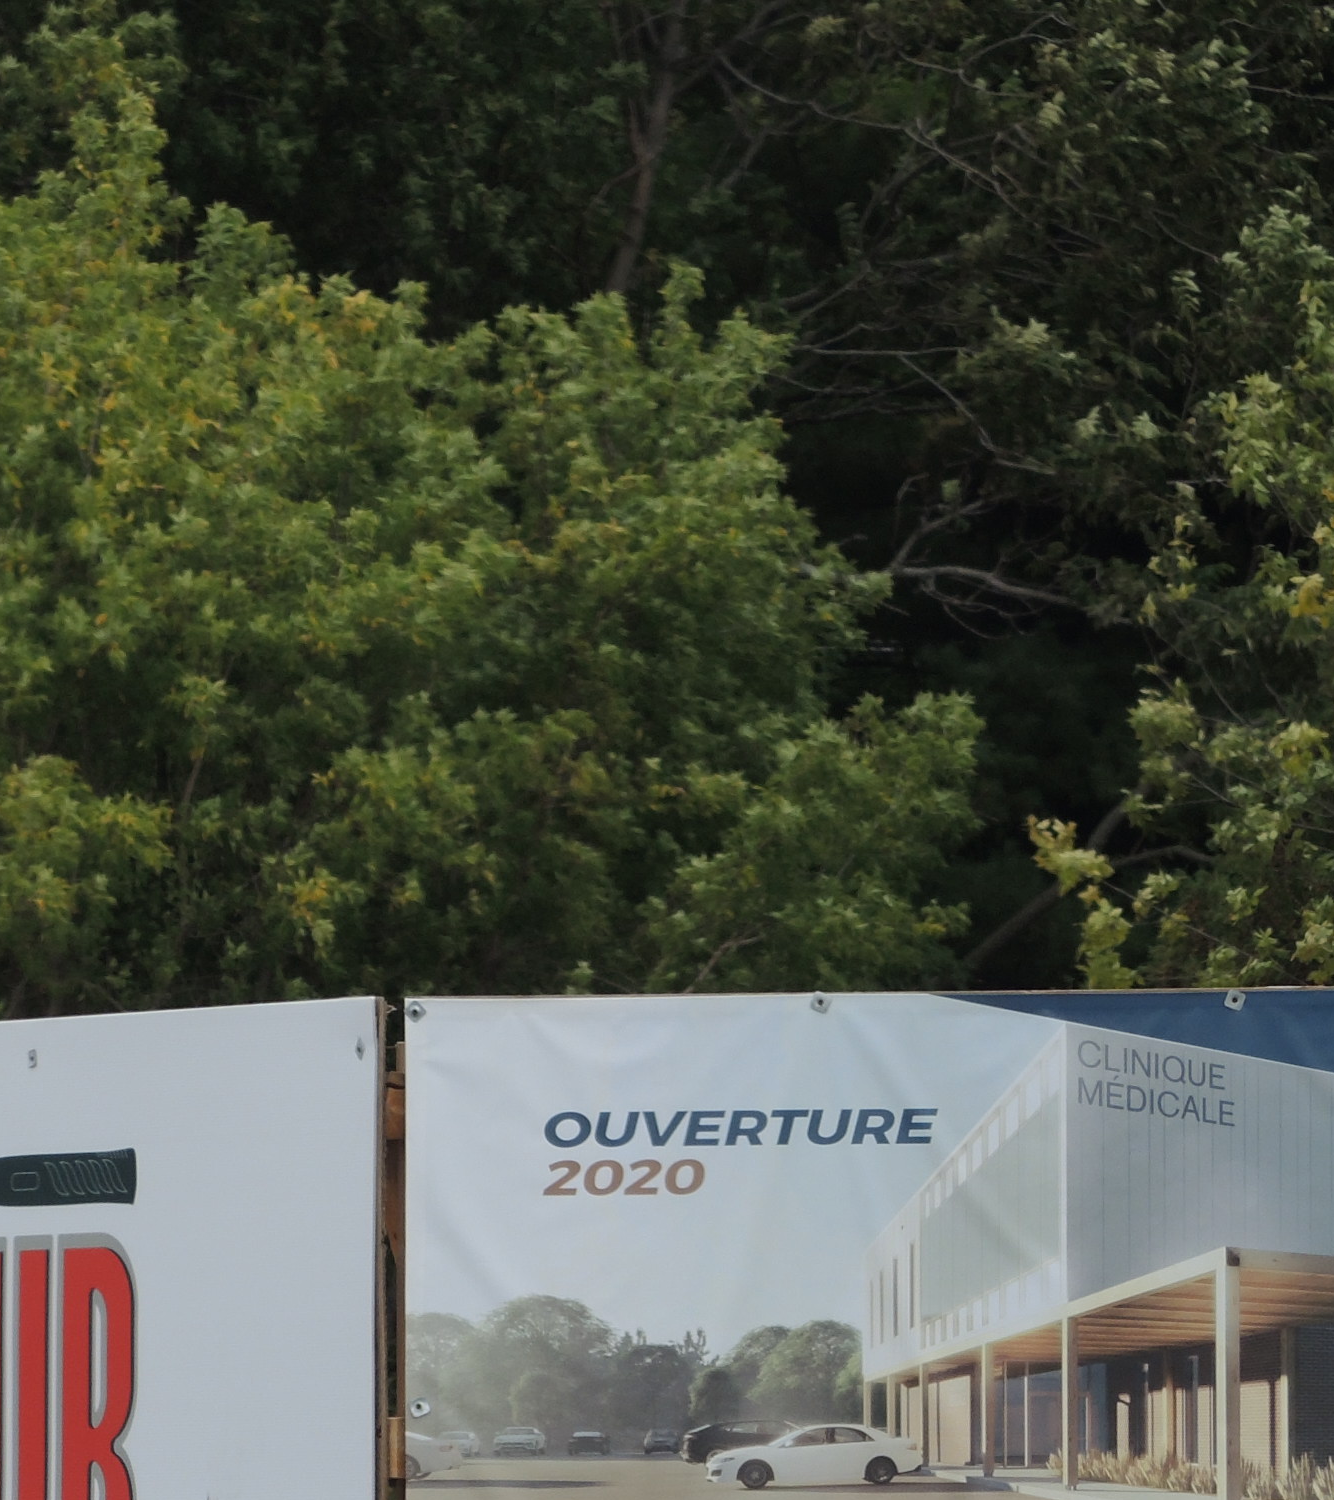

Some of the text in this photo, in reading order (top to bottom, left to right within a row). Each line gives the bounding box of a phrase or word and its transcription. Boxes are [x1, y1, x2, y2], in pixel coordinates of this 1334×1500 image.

[1077, 1040, 1226, 1090] CLINIQUE
[1077, 1075, 1236, 1126] MÉDICALE
[543, 1108, 939, 1148] OUVERTURE
[542, 1158, 706, 1196] 2020
